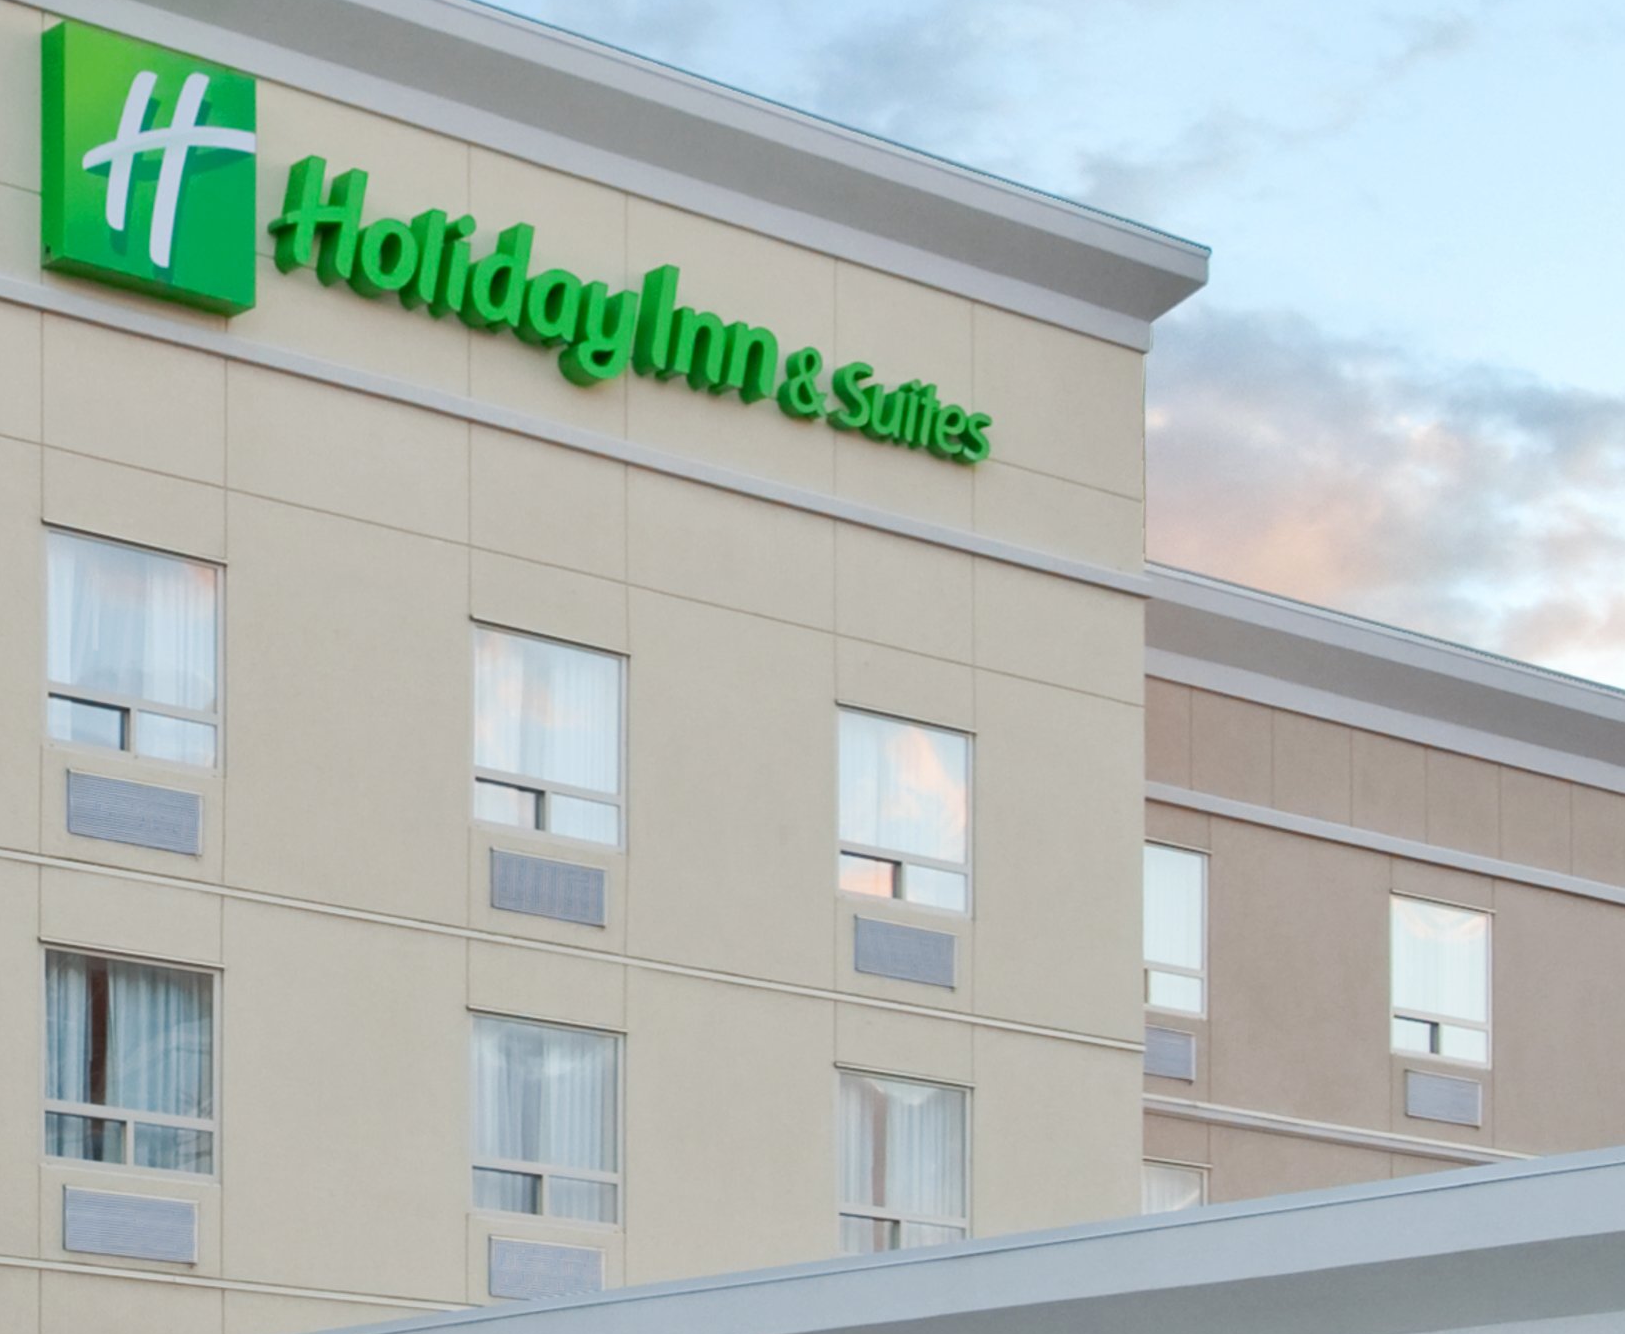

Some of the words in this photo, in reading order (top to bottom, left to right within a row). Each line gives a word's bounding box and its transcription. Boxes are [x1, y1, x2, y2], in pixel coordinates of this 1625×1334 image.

[268, 154, 639, 387] Holiday
[632, 264, 778, 405] Inn
[777, 347, 827, 422] &
[827, 361, 992, 463] Suites
